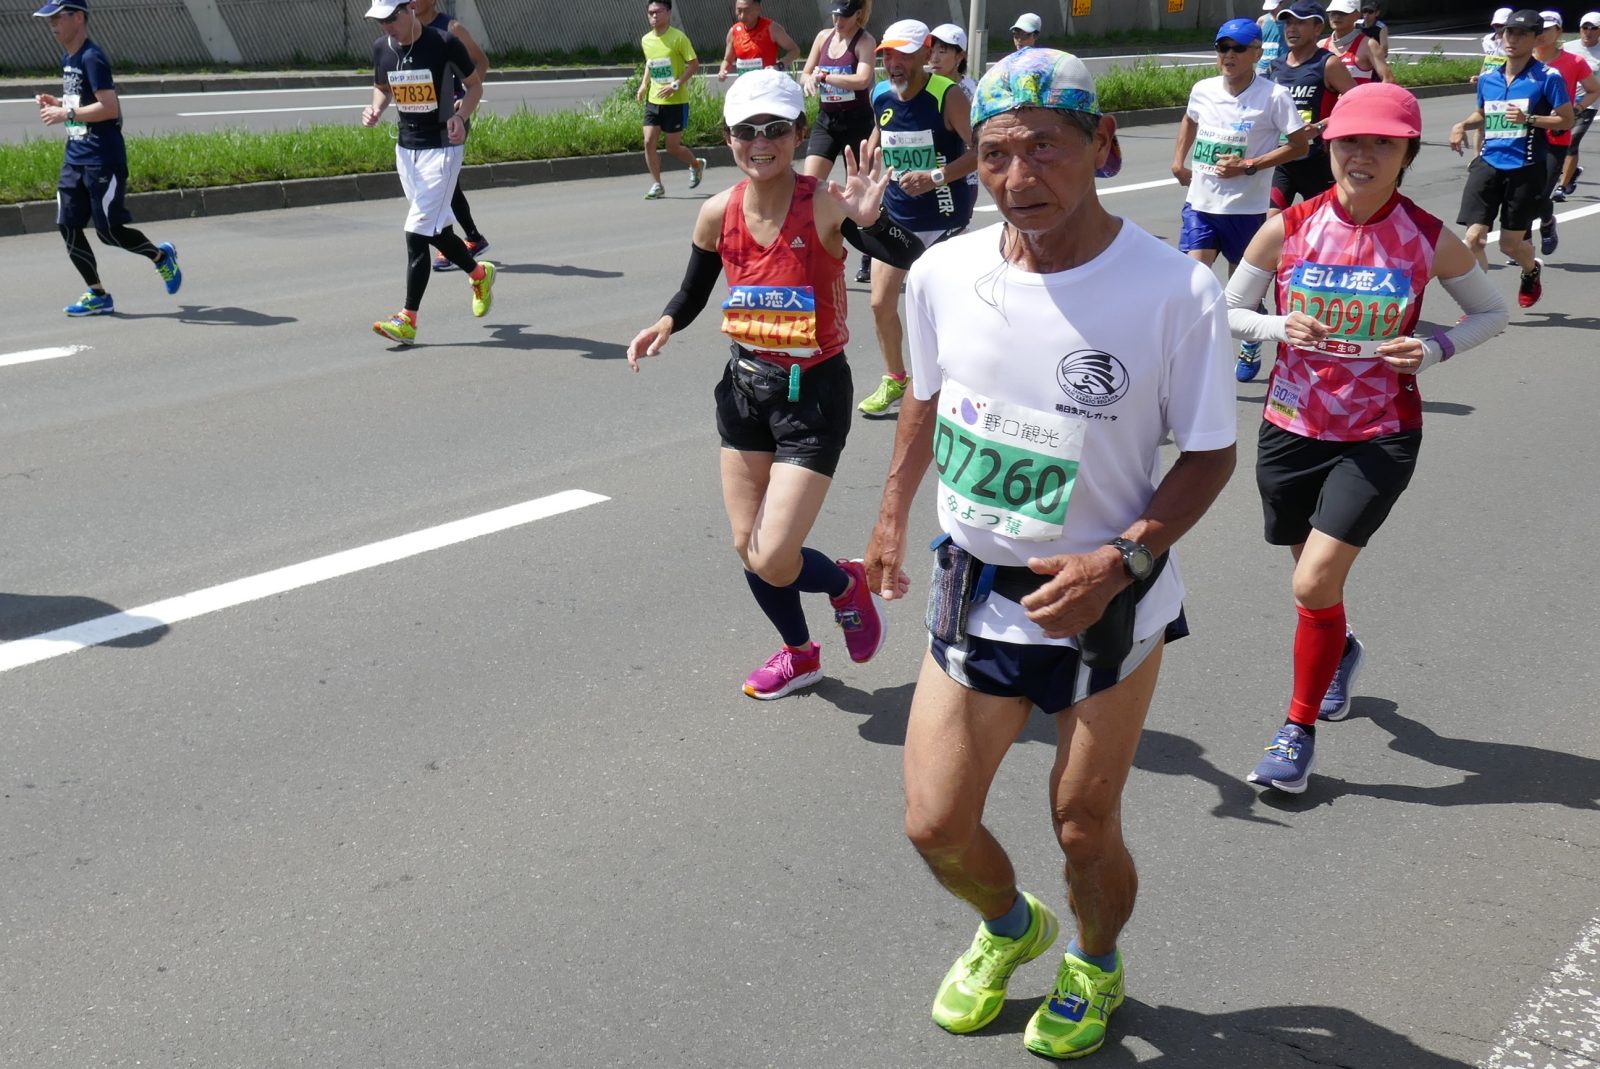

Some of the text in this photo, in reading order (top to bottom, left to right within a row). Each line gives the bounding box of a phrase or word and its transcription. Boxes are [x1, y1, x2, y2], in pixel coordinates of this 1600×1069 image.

[883, 148, 932, 169] D5407
[1301, 266, 1397, 293] 白い恋人
[728, 289, 803, 309] 白い恋人
[1289, 290, 1401, 337] D20919
[727, 312, 812, 346] E21473
[1273, 385, 1289, 401] GO
[983, 413, 1060, 448] 野口観光
[935, 421, 1067, 515] D7260
[961, 505, 1023, 535] よつ葉
